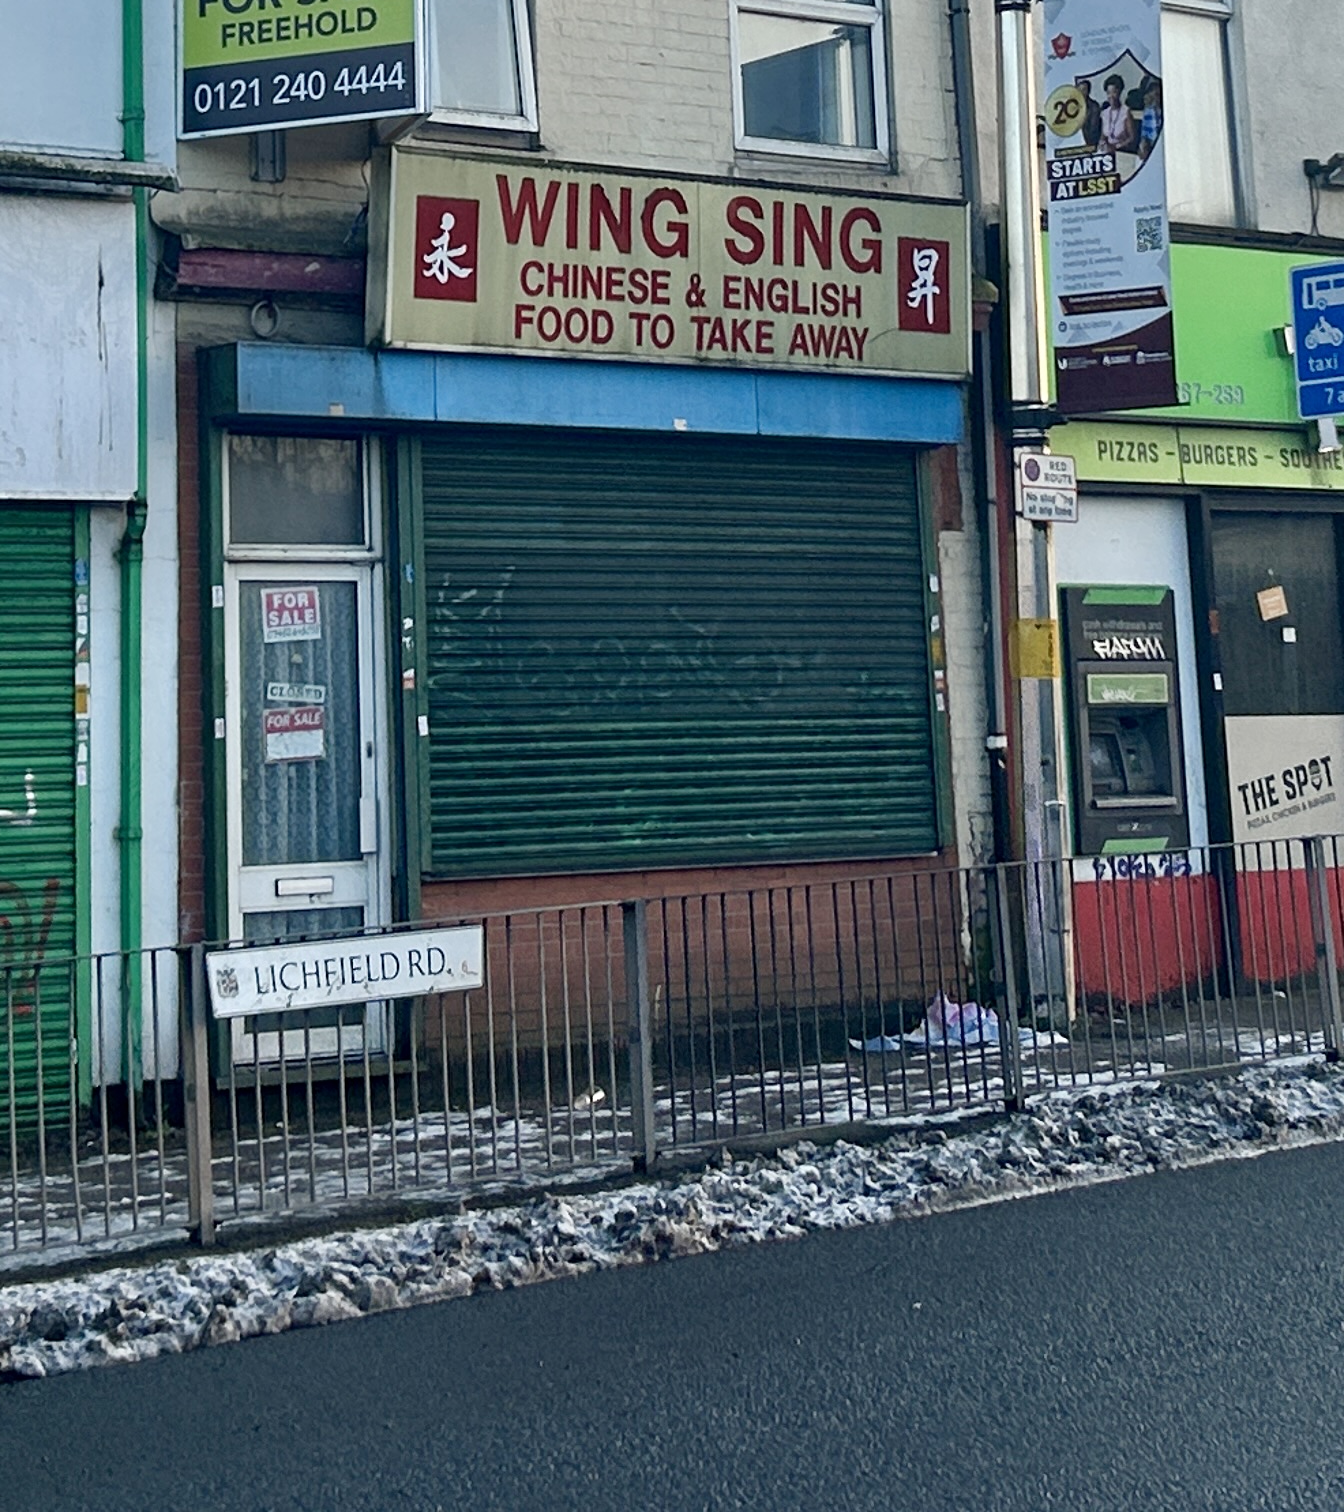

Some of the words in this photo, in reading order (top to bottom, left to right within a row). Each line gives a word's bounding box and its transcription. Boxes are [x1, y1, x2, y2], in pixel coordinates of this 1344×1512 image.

[221, 7, 377, 48] FREEHOLD
[194, 78, 259, 113] 0121
[272, 70, 326, 104] 240
[334, 60, 405, 96] 4444
[1051, 155, 1113, 178] STARTS
[1056, 182, 1076, 198] AT
[1078, 177, 1116, 195] LSST
[496, 174, 689, 258] WING
[724, 195, 883, 274] SING
[422, 211, 474, 284] 永
[520, 260, 671, 306] CHINESE
[685, 272, 706, 308] &
[723, 275, 862, 319] ENGLISH
[513, 304, 614, 346] FOOD
[629, 311, 675, 349] TO
[691, 316, 775, 355] TAKE
[789, 323, 870, 361] AWAY
[1308, 353, 1338, 372] taxi
[1097, 440, 1159, 463] PIZZAS
[1181, 443, 1257, 466] BURGERS
[268, 608, 315, 626] SALE
[272, 593, 309, 608] FOR
[267, 714, 290, 728] FOR
[294, 711, 321, 726] SALE
[1237, 774, 1279, 815] THE
[1282, 755, 1332, 800] SPOT
[255, 951, 400, 994] LICHFIELD
